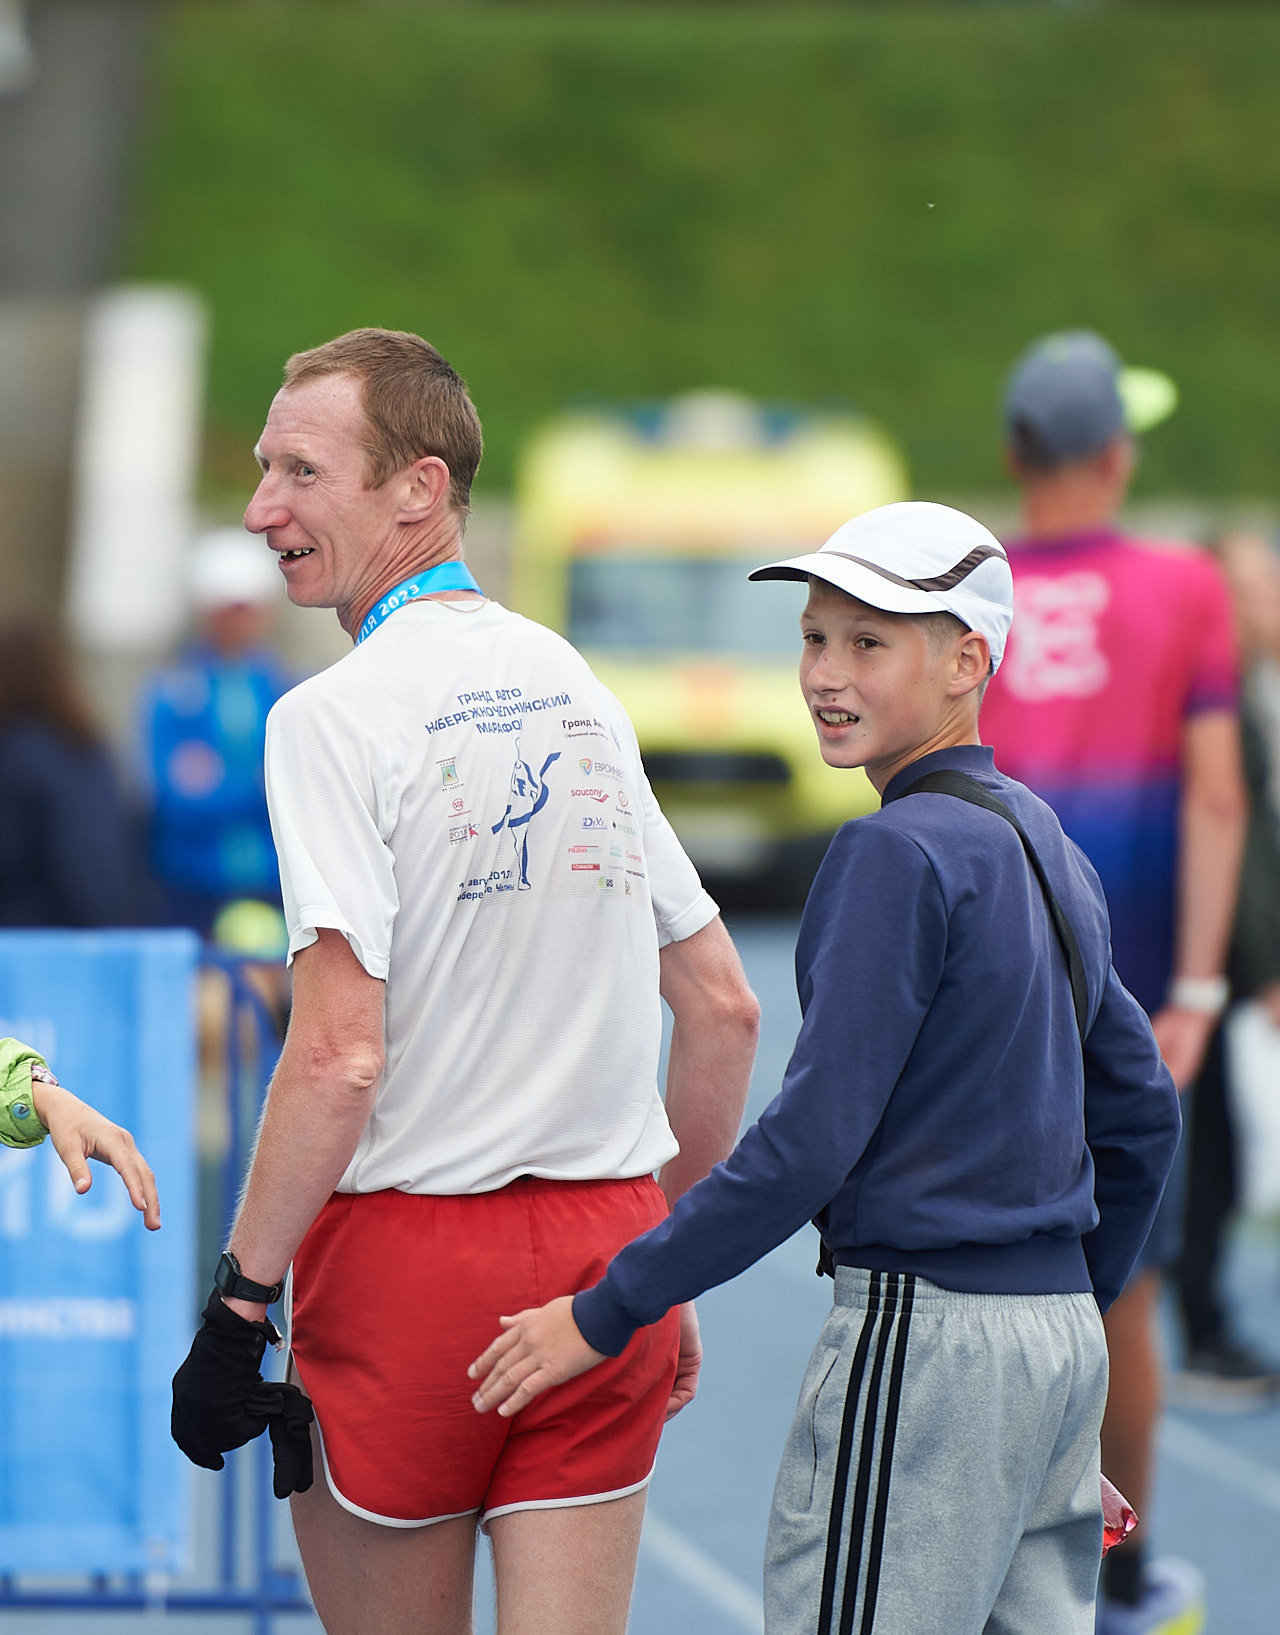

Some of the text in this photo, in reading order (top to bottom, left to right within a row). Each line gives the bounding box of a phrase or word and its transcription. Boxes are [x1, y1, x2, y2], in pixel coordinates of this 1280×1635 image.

[379, 584, 420, 616] 2023
[457, 688, 523, 706] ГРАНД АВТО
[562, 719, 592, 730] Гранд
[570, 788, 603, 798] saucony
[468, 878, 489, 888] авгу
